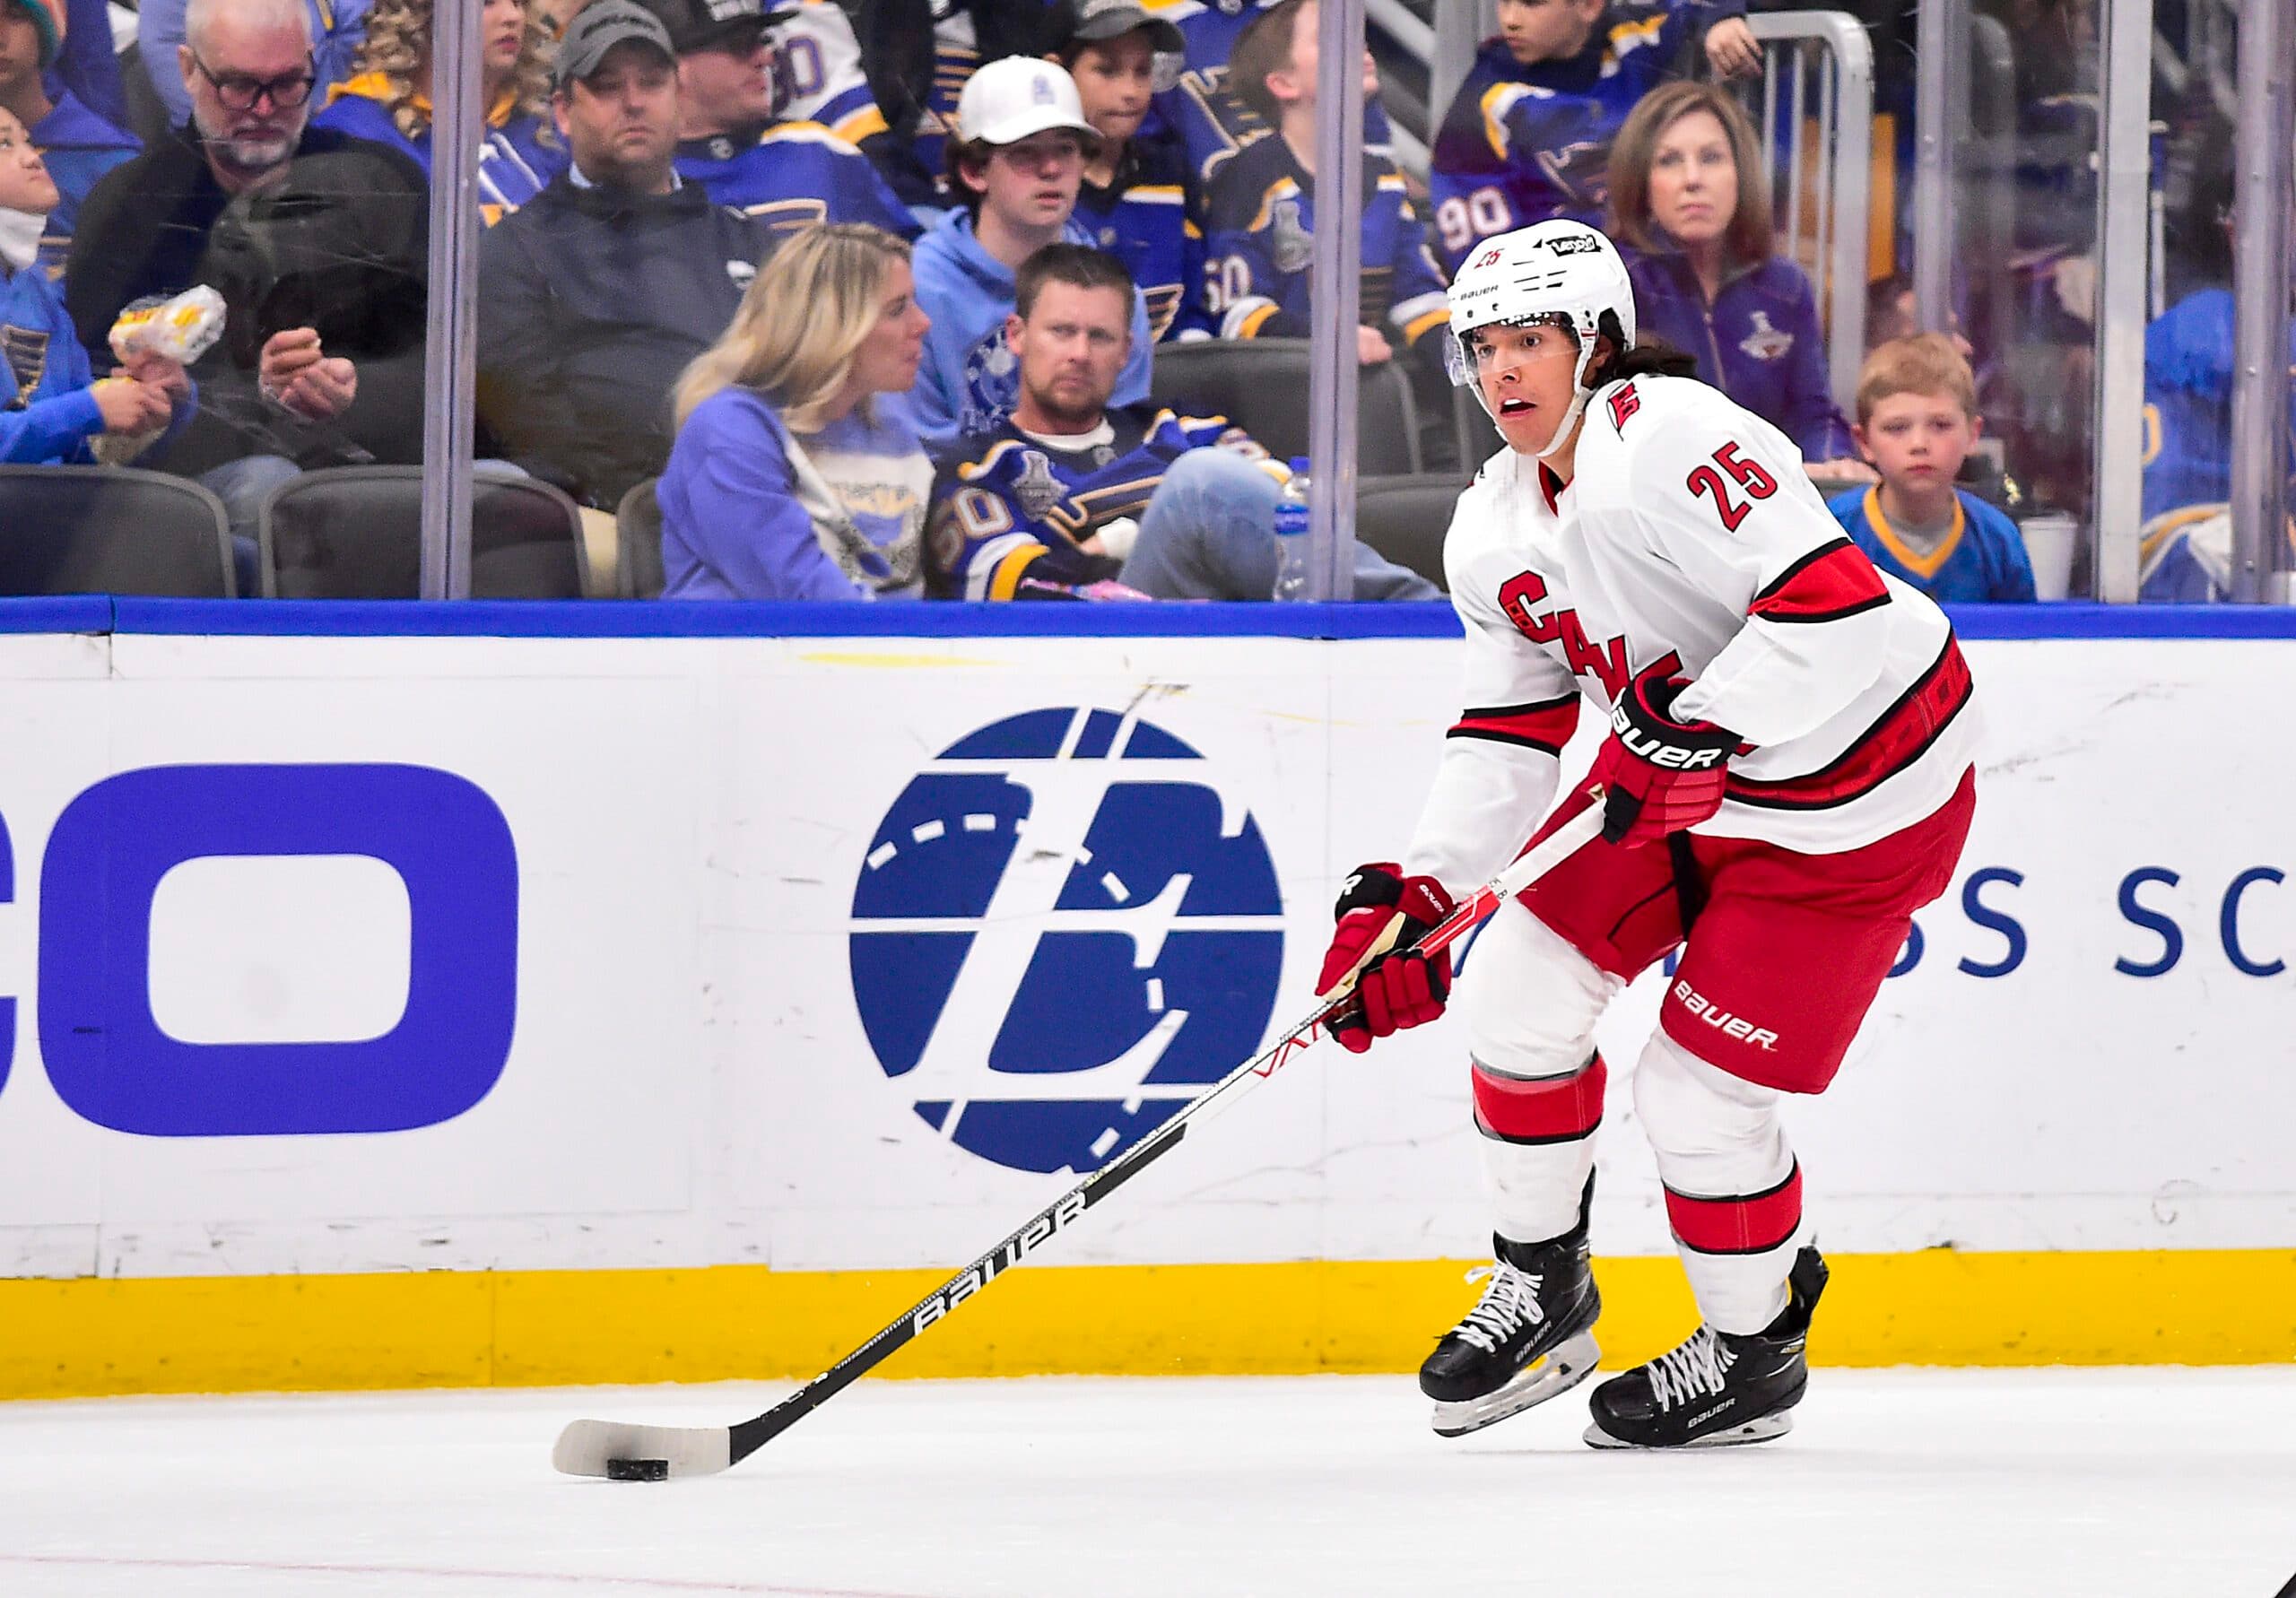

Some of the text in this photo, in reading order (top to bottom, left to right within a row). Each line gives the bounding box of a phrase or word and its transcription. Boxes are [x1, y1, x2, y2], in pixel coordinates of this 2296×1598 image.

[1437, 185, 1512, 252] 90
[1687, 440, 1779, 534] 25
[0, 767, 519, 1136] O
